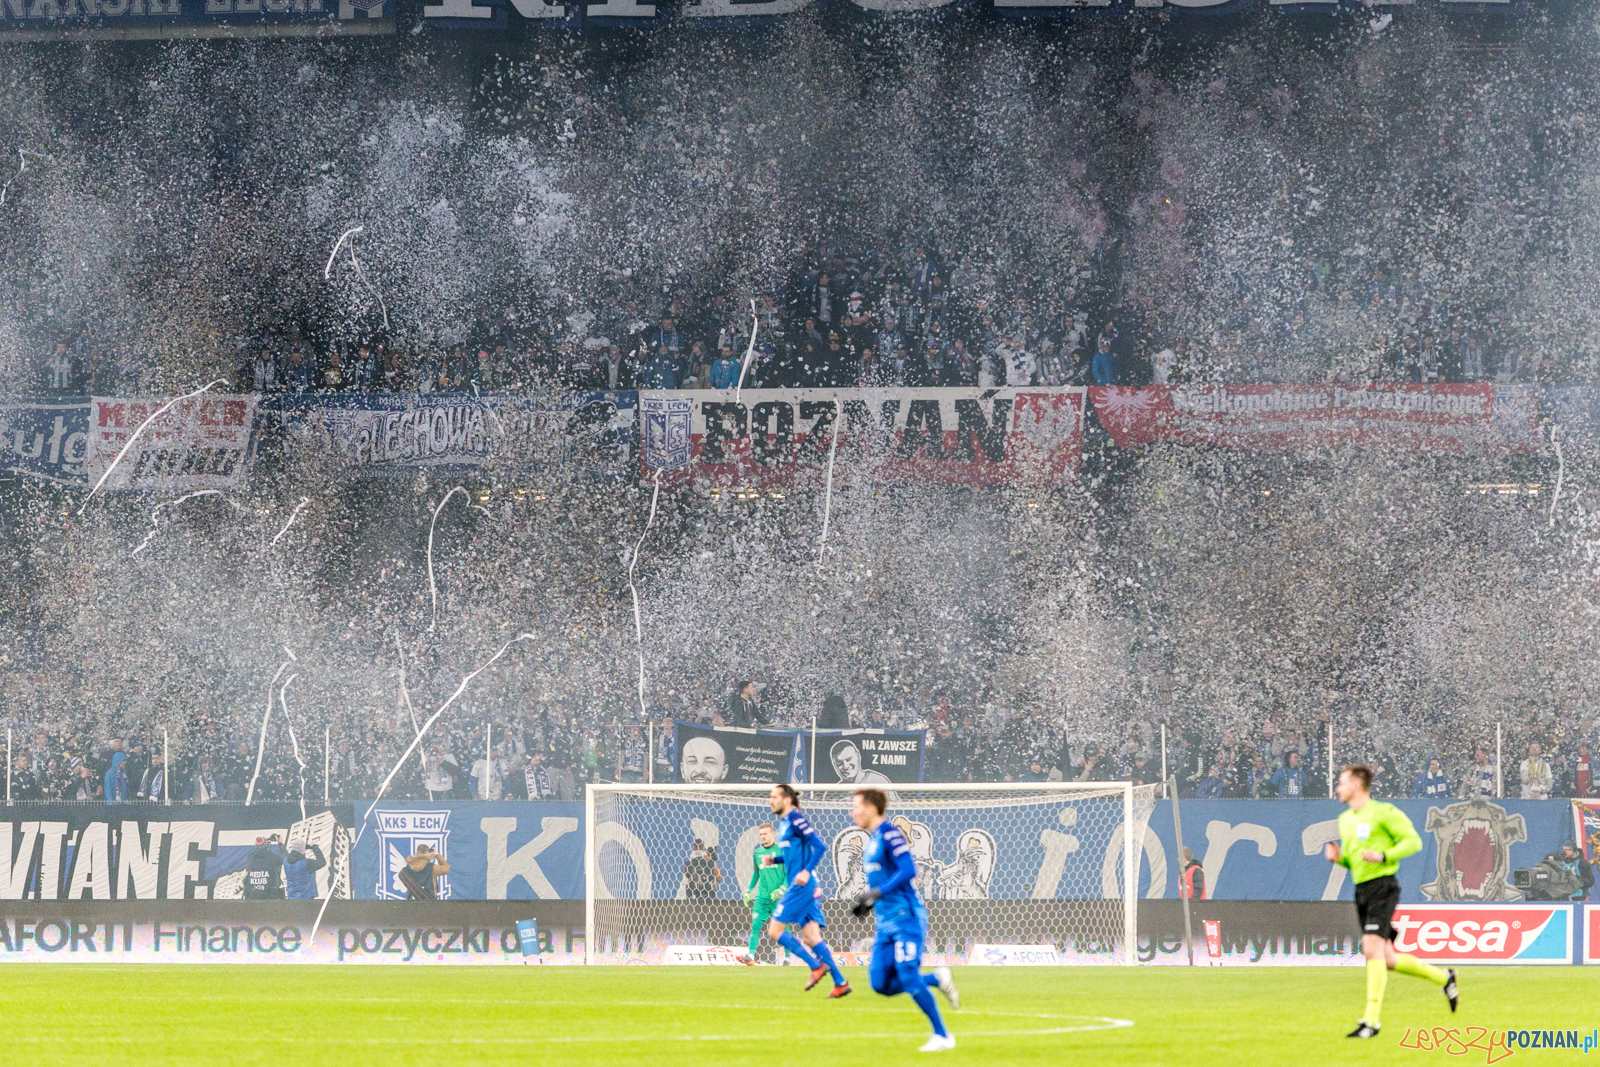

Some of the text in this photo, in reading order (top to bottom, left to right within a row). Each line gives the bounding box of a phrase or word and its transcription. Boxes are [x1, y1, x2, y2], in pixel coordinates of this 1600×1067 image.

[862, 740, 917, 751] NA ZAWSZE
[871, 754, 907, 765] Z NAMI
[385, 817, 441, 829] KKS LECH
[153, 920, 302, 953] Finance
[1391, 915, 1509, 952] tesa
[1013, 951, 1056, 964] AFORTI
